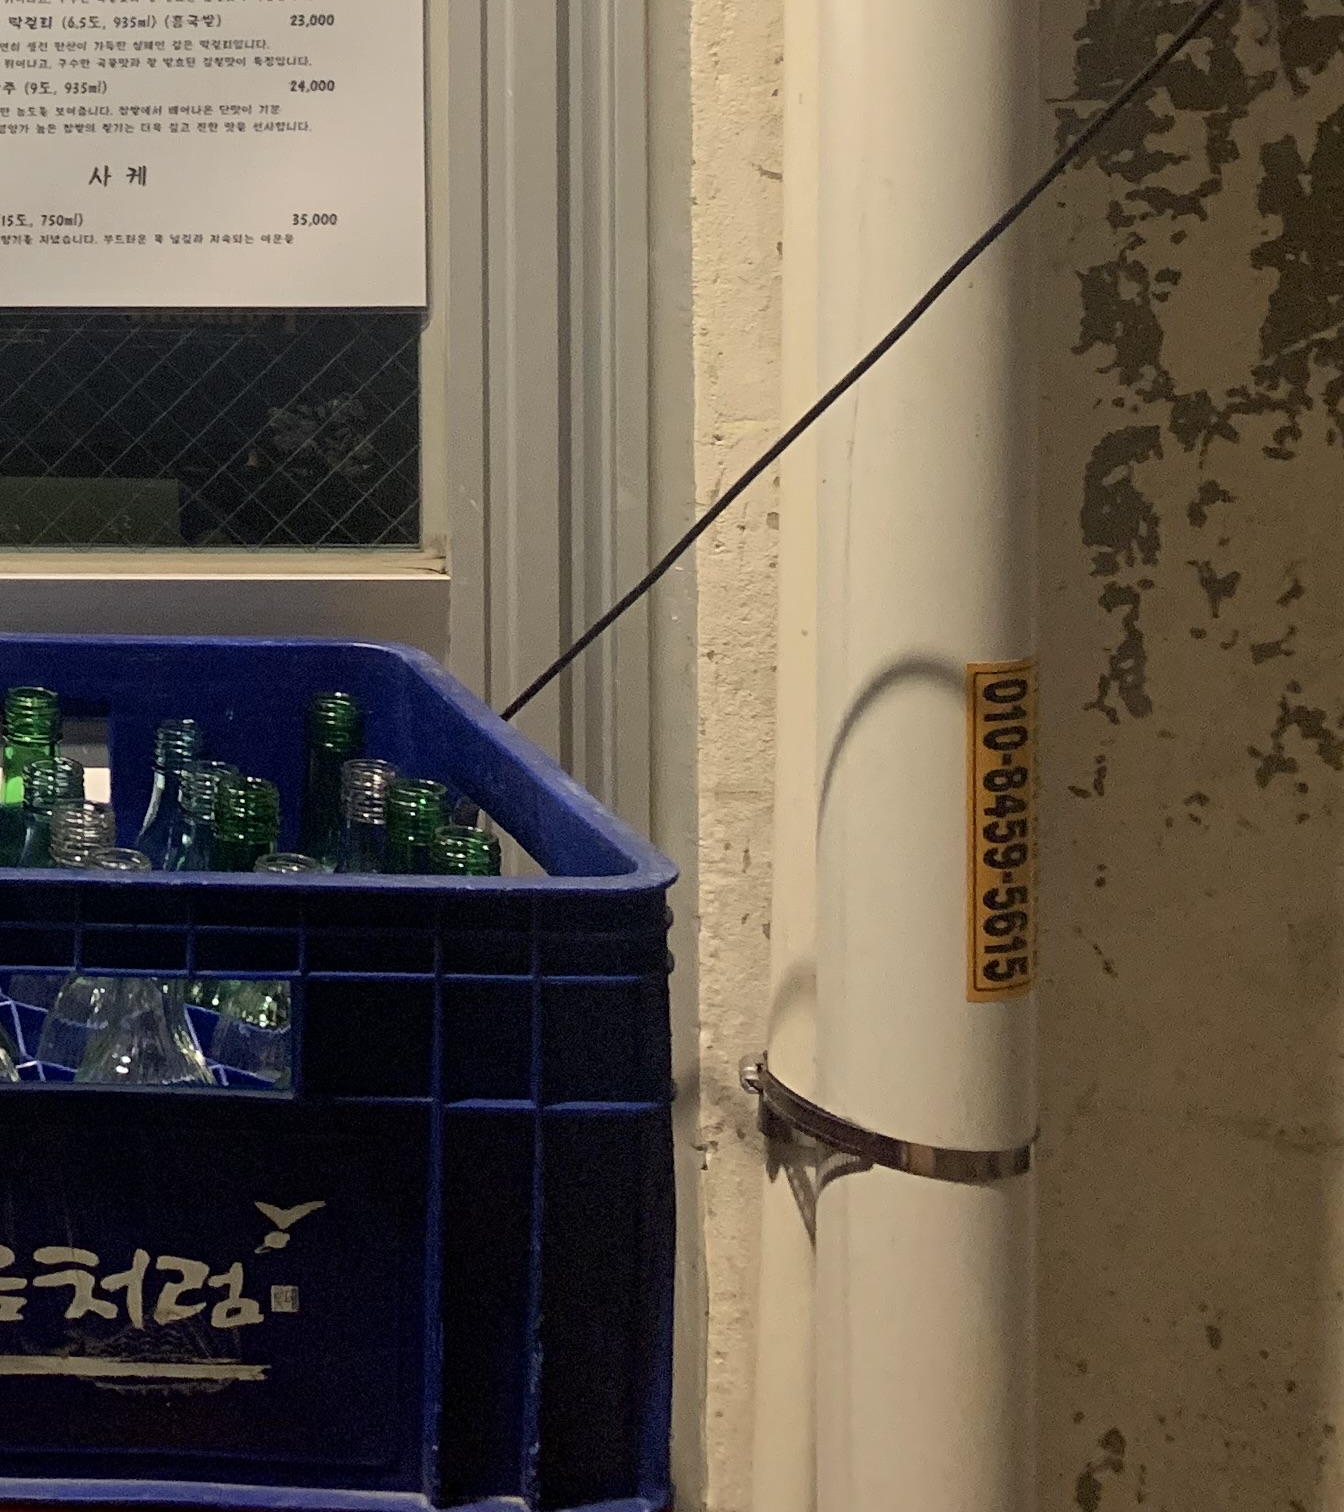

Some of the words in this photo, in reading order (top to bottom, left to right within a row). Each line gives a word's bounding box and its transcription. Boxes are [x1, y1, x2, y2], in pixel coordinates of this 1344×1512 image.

[289, 13, 336, 29] 23,000
[288, 79, 336, 94] 24,000
[40, 212, 84, 228] 750ml)
[292, 212, 339, 228] 35,000
[982, 678, 1029, 983] 010-8459-5615
